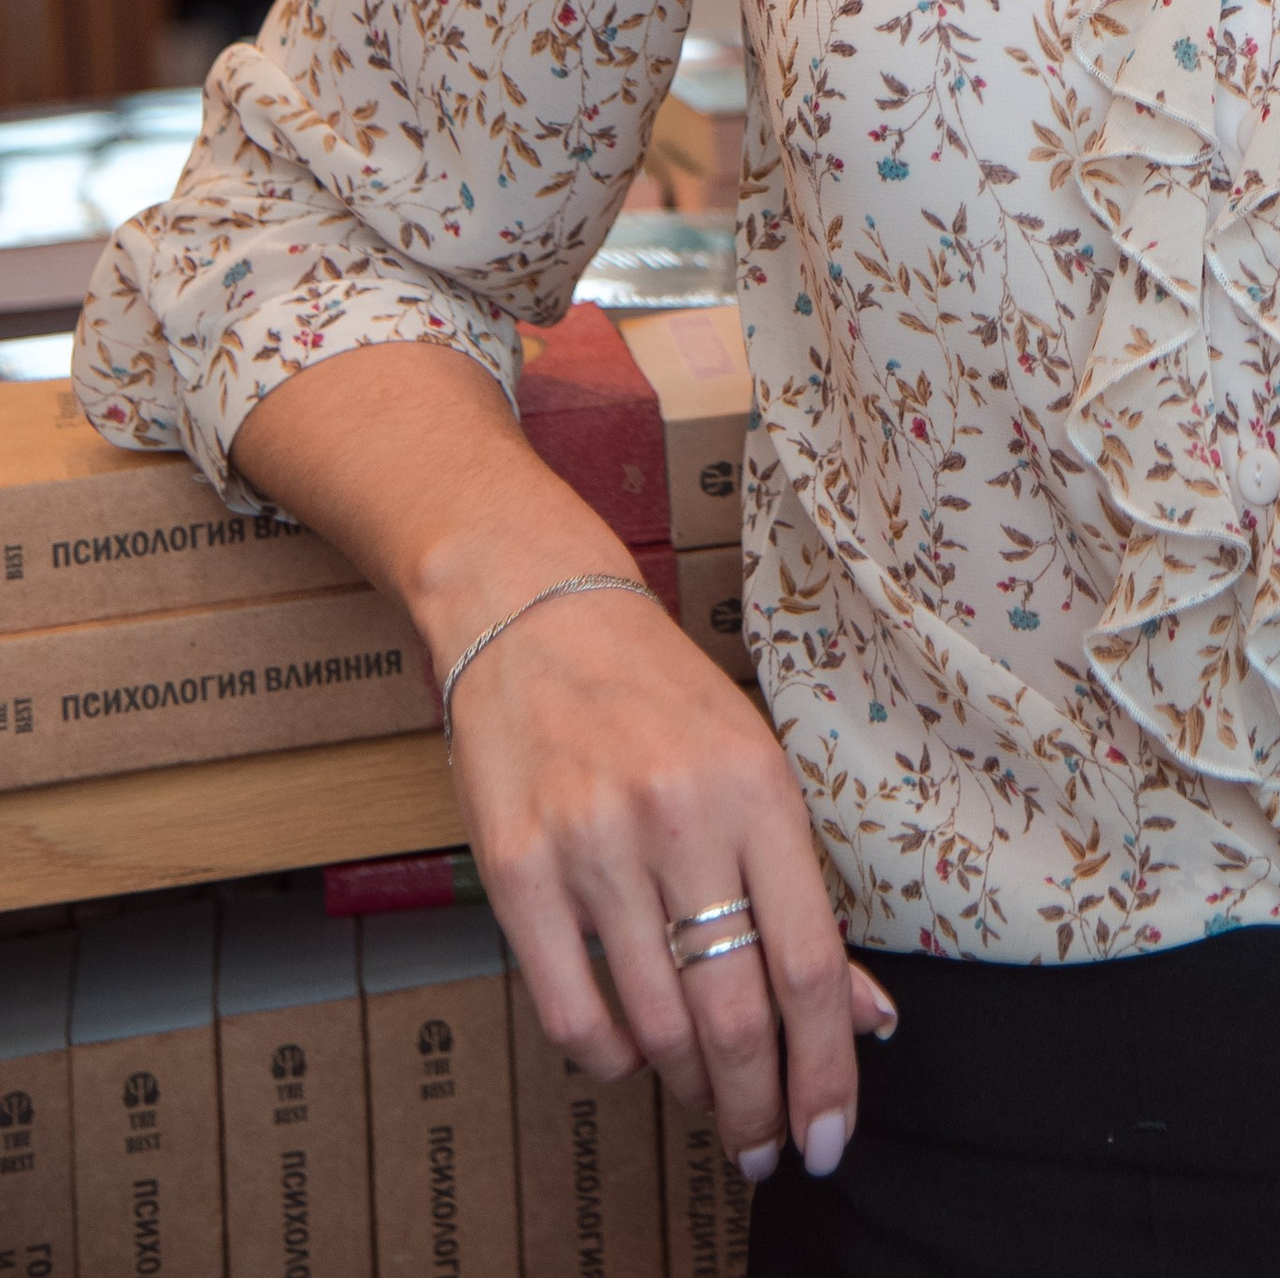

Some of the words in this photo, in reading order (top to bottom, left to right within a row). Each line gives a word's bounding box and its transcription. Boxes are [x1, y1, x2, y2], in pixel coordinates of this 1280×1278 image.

[5, 544, 23, 580] BEST
[52, 518, 246, 568] ПСИХОЛОГИЯ
[61, 668, 257, 722] ПСИХОЛОГИЯ
[264, 648, 403, 692] ВЛИЯНИЯ
[14, 697, 34, 734] BEST
[125, 1133, 161, 1155] BEST
[428, 1125, 460, 1278] ПСИХОЛОГ
[133, 1178, 162, 1276] ПСИХО
